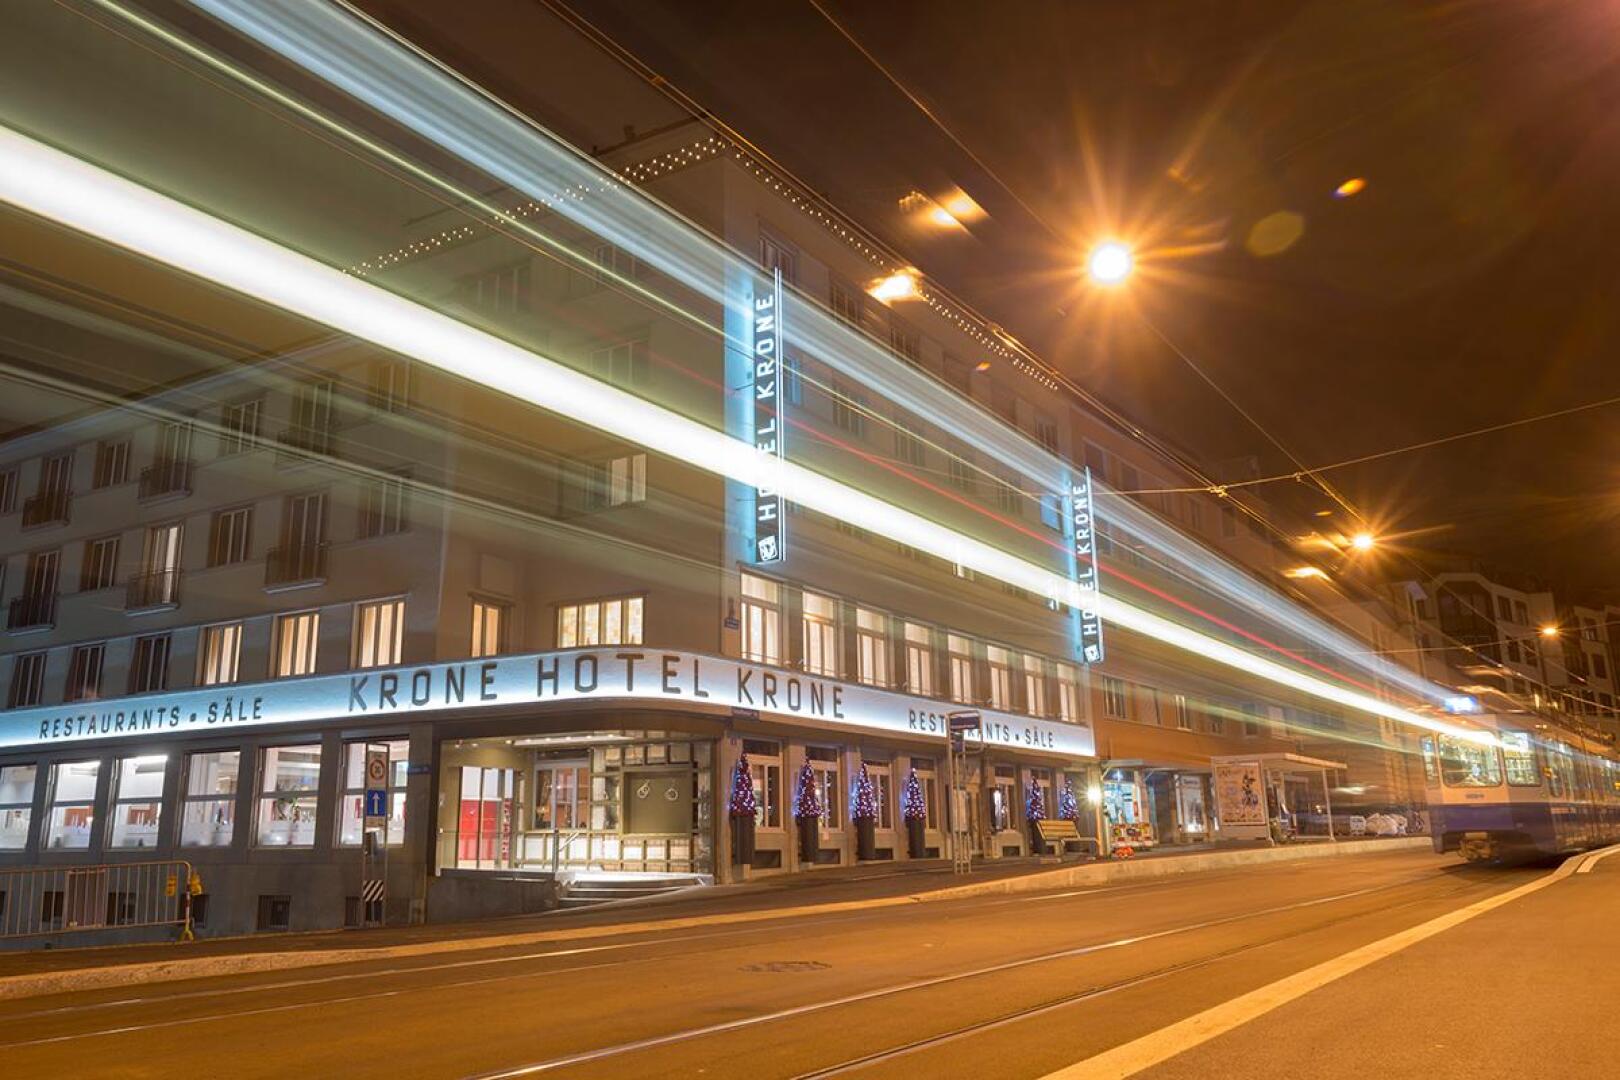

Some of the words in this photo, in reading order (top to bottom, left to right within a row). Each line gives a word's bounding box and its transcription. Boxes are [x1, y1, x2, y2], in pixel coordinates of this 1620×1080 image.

[756, 293, 775, 400] KRONE
[757, 418, 777, 521] HOEL
[1073, 484, 1091, 555] KRONE
[1080, 567, 1097, 635] HOEL
[39, 706, 180, 740] RESTAURANTS
[208, 697, 263, 724] SÄLE
[349, 663, 498, 712] KRONE
[537, 653, 709, 698] HOTEL
[737, 667, 844, 719] KRONE
[909, 709, 1010, 742] RESTNTS
[1025, 727, 1054, 748] SÄLE
